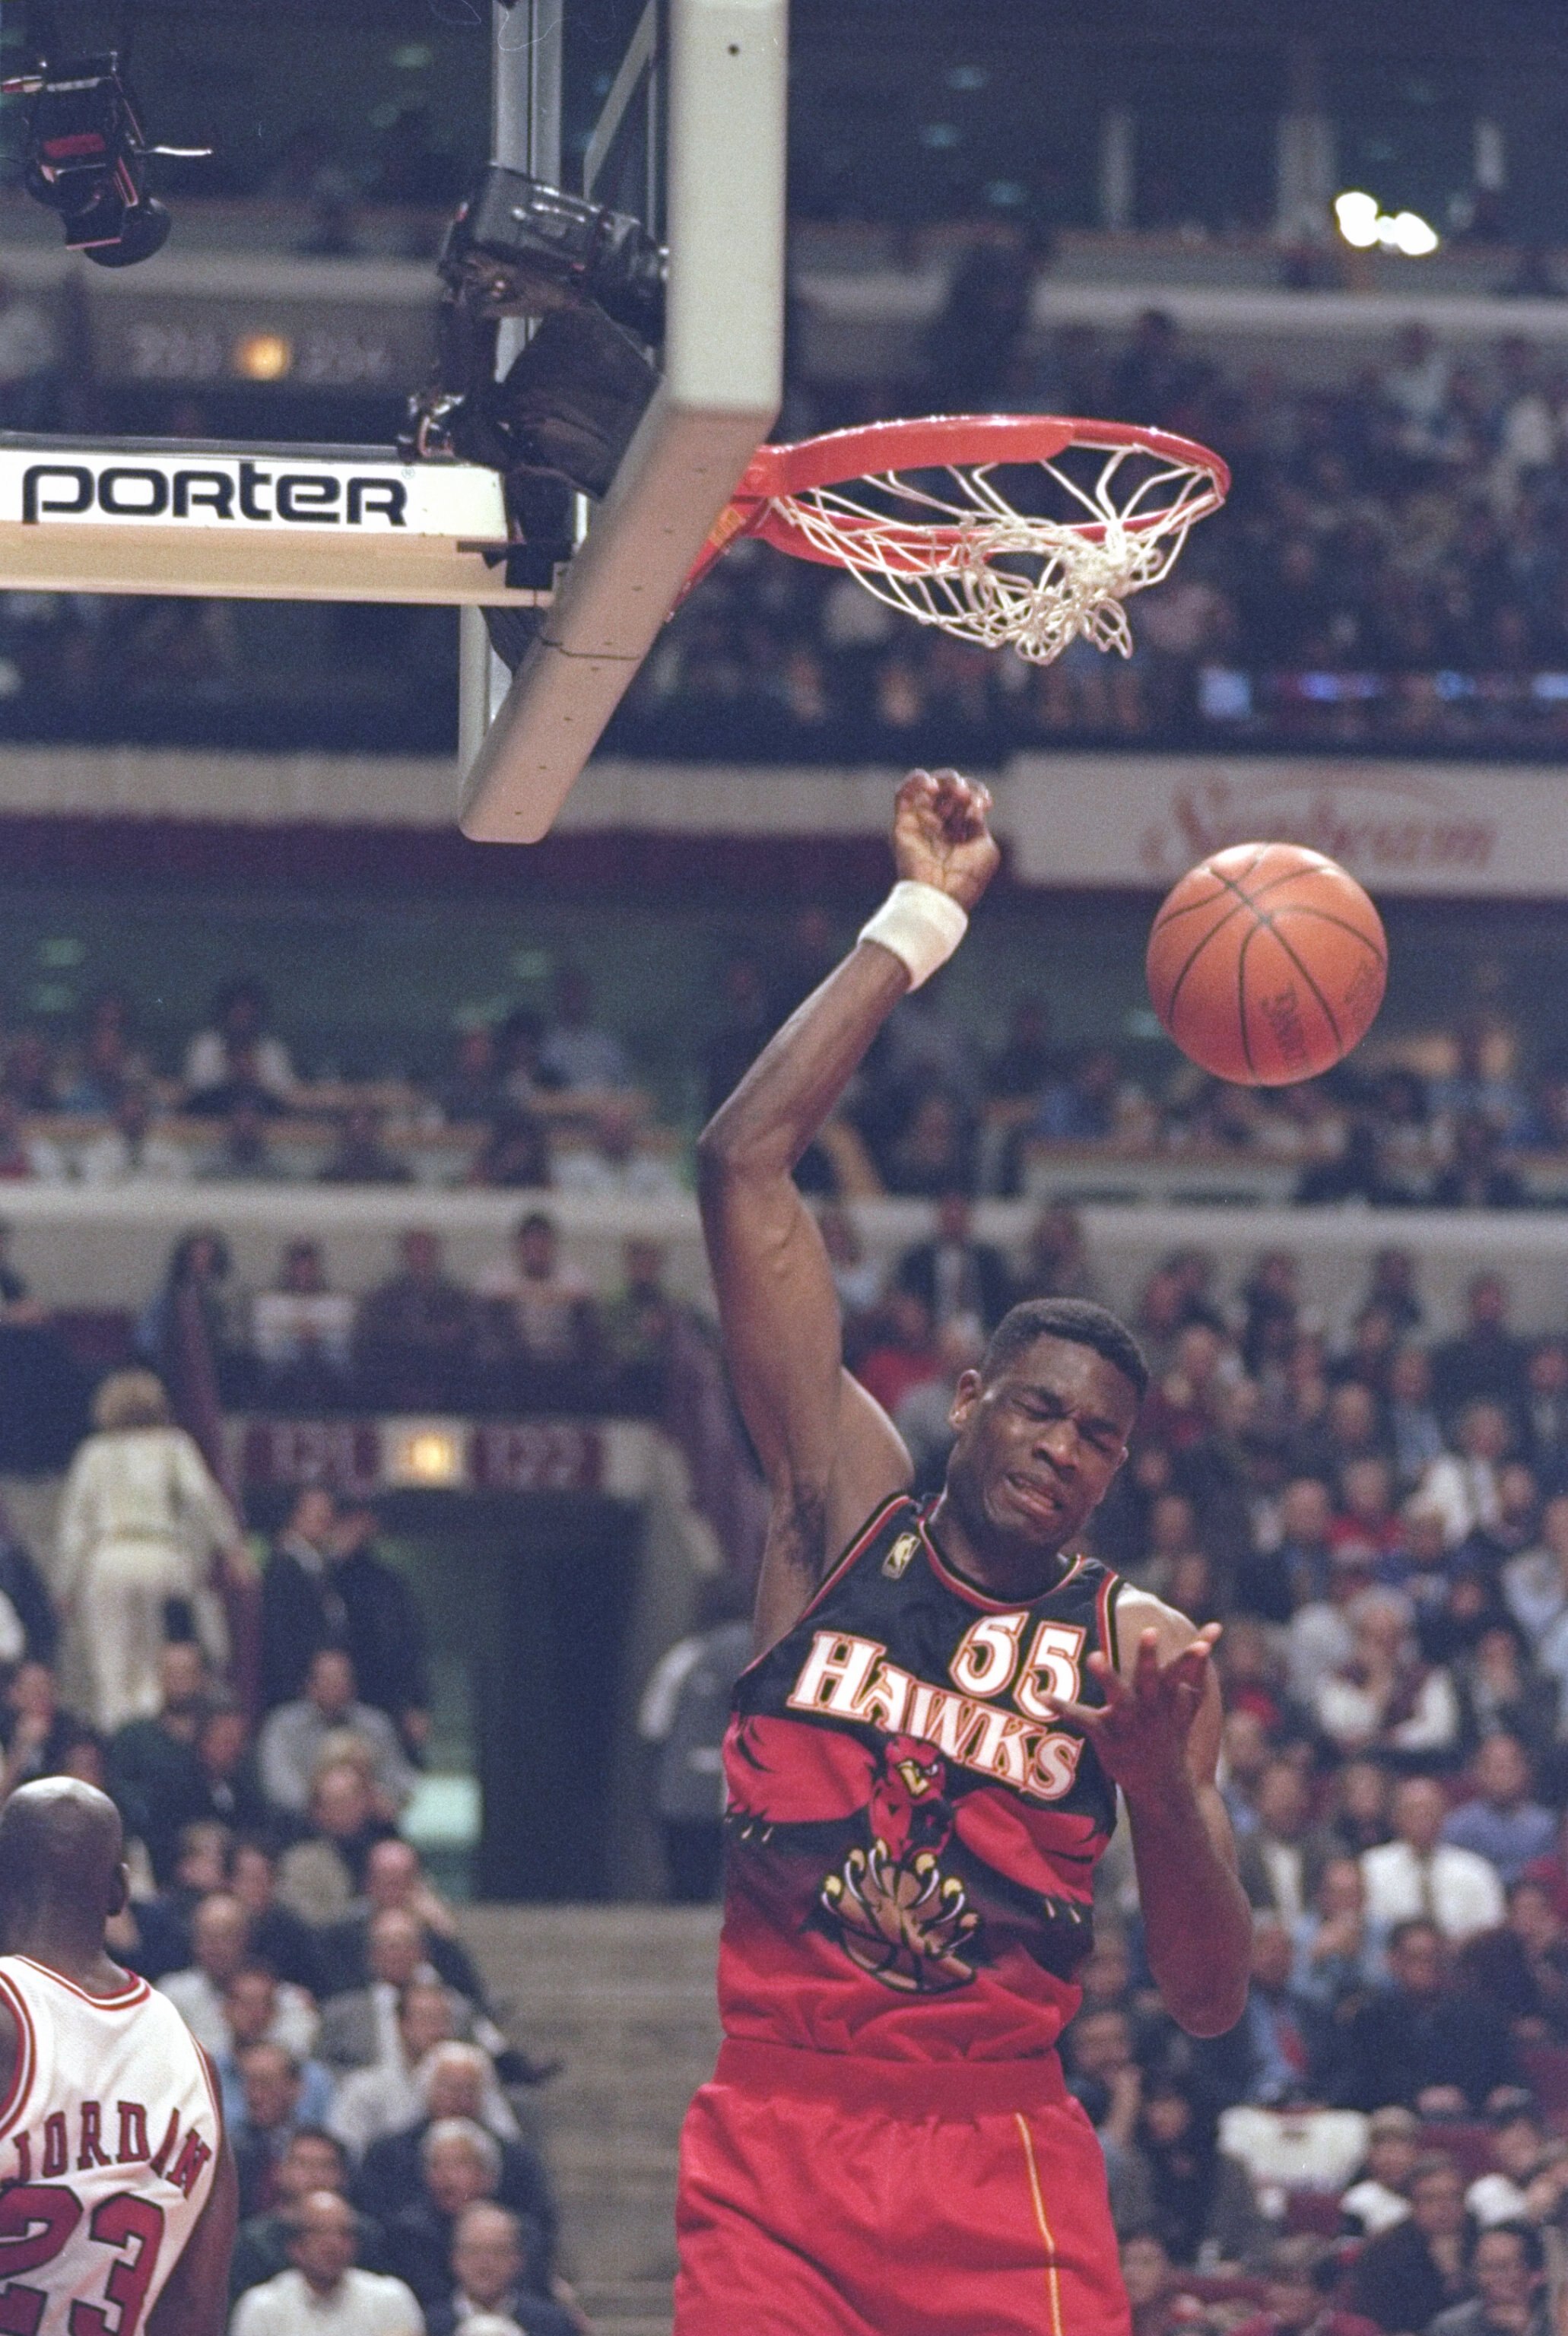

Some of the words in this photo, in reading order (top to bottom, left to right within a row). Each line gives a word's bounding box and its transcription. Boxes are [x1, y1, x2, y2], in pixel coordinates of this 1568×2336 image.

[786, 1630, 1085, 1801] HAWKS
[948, 1611, 1086, 1721] 55
[0, 2182, 165, 2336] 23
